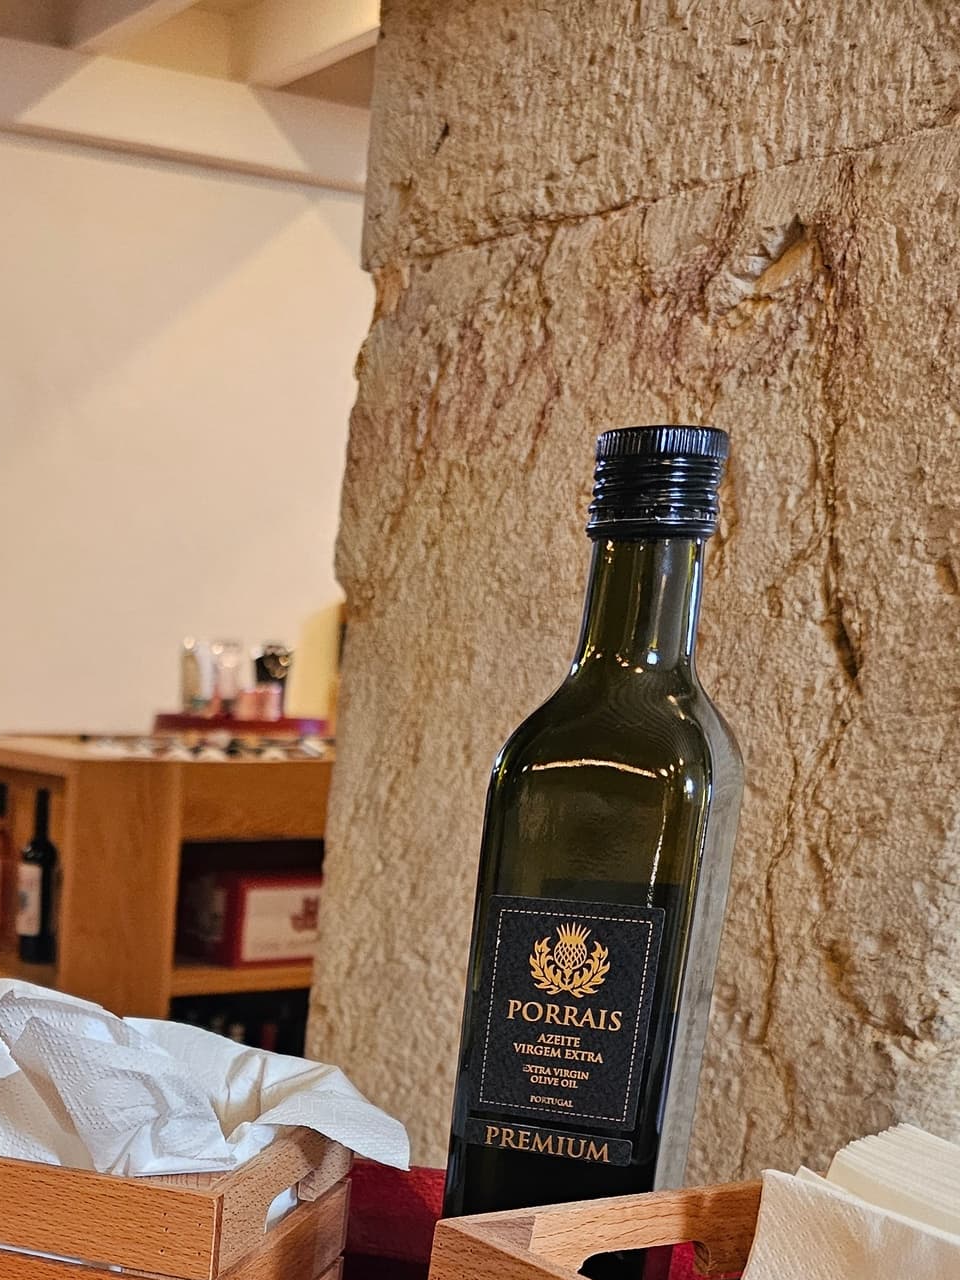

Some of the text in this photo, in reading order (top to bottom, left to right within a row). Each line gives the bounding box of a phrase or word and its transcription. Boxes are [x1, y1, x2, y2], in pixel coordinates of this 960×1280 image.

[506, 999, 623, 1032] PORRAIS
[537, 1033, 581, 1048] AZEITE
[513, 1042, 604, 1064] VIRGEM EXTRA
[522, 1063, 590, 1080] EXTRA VIRGIN
[530, 1075, 579, 1089] OLIVE OIL
[529, 1095, 574, 1108] PORTUGAL
[484, 1125, 611, 1163] PREMIUM
